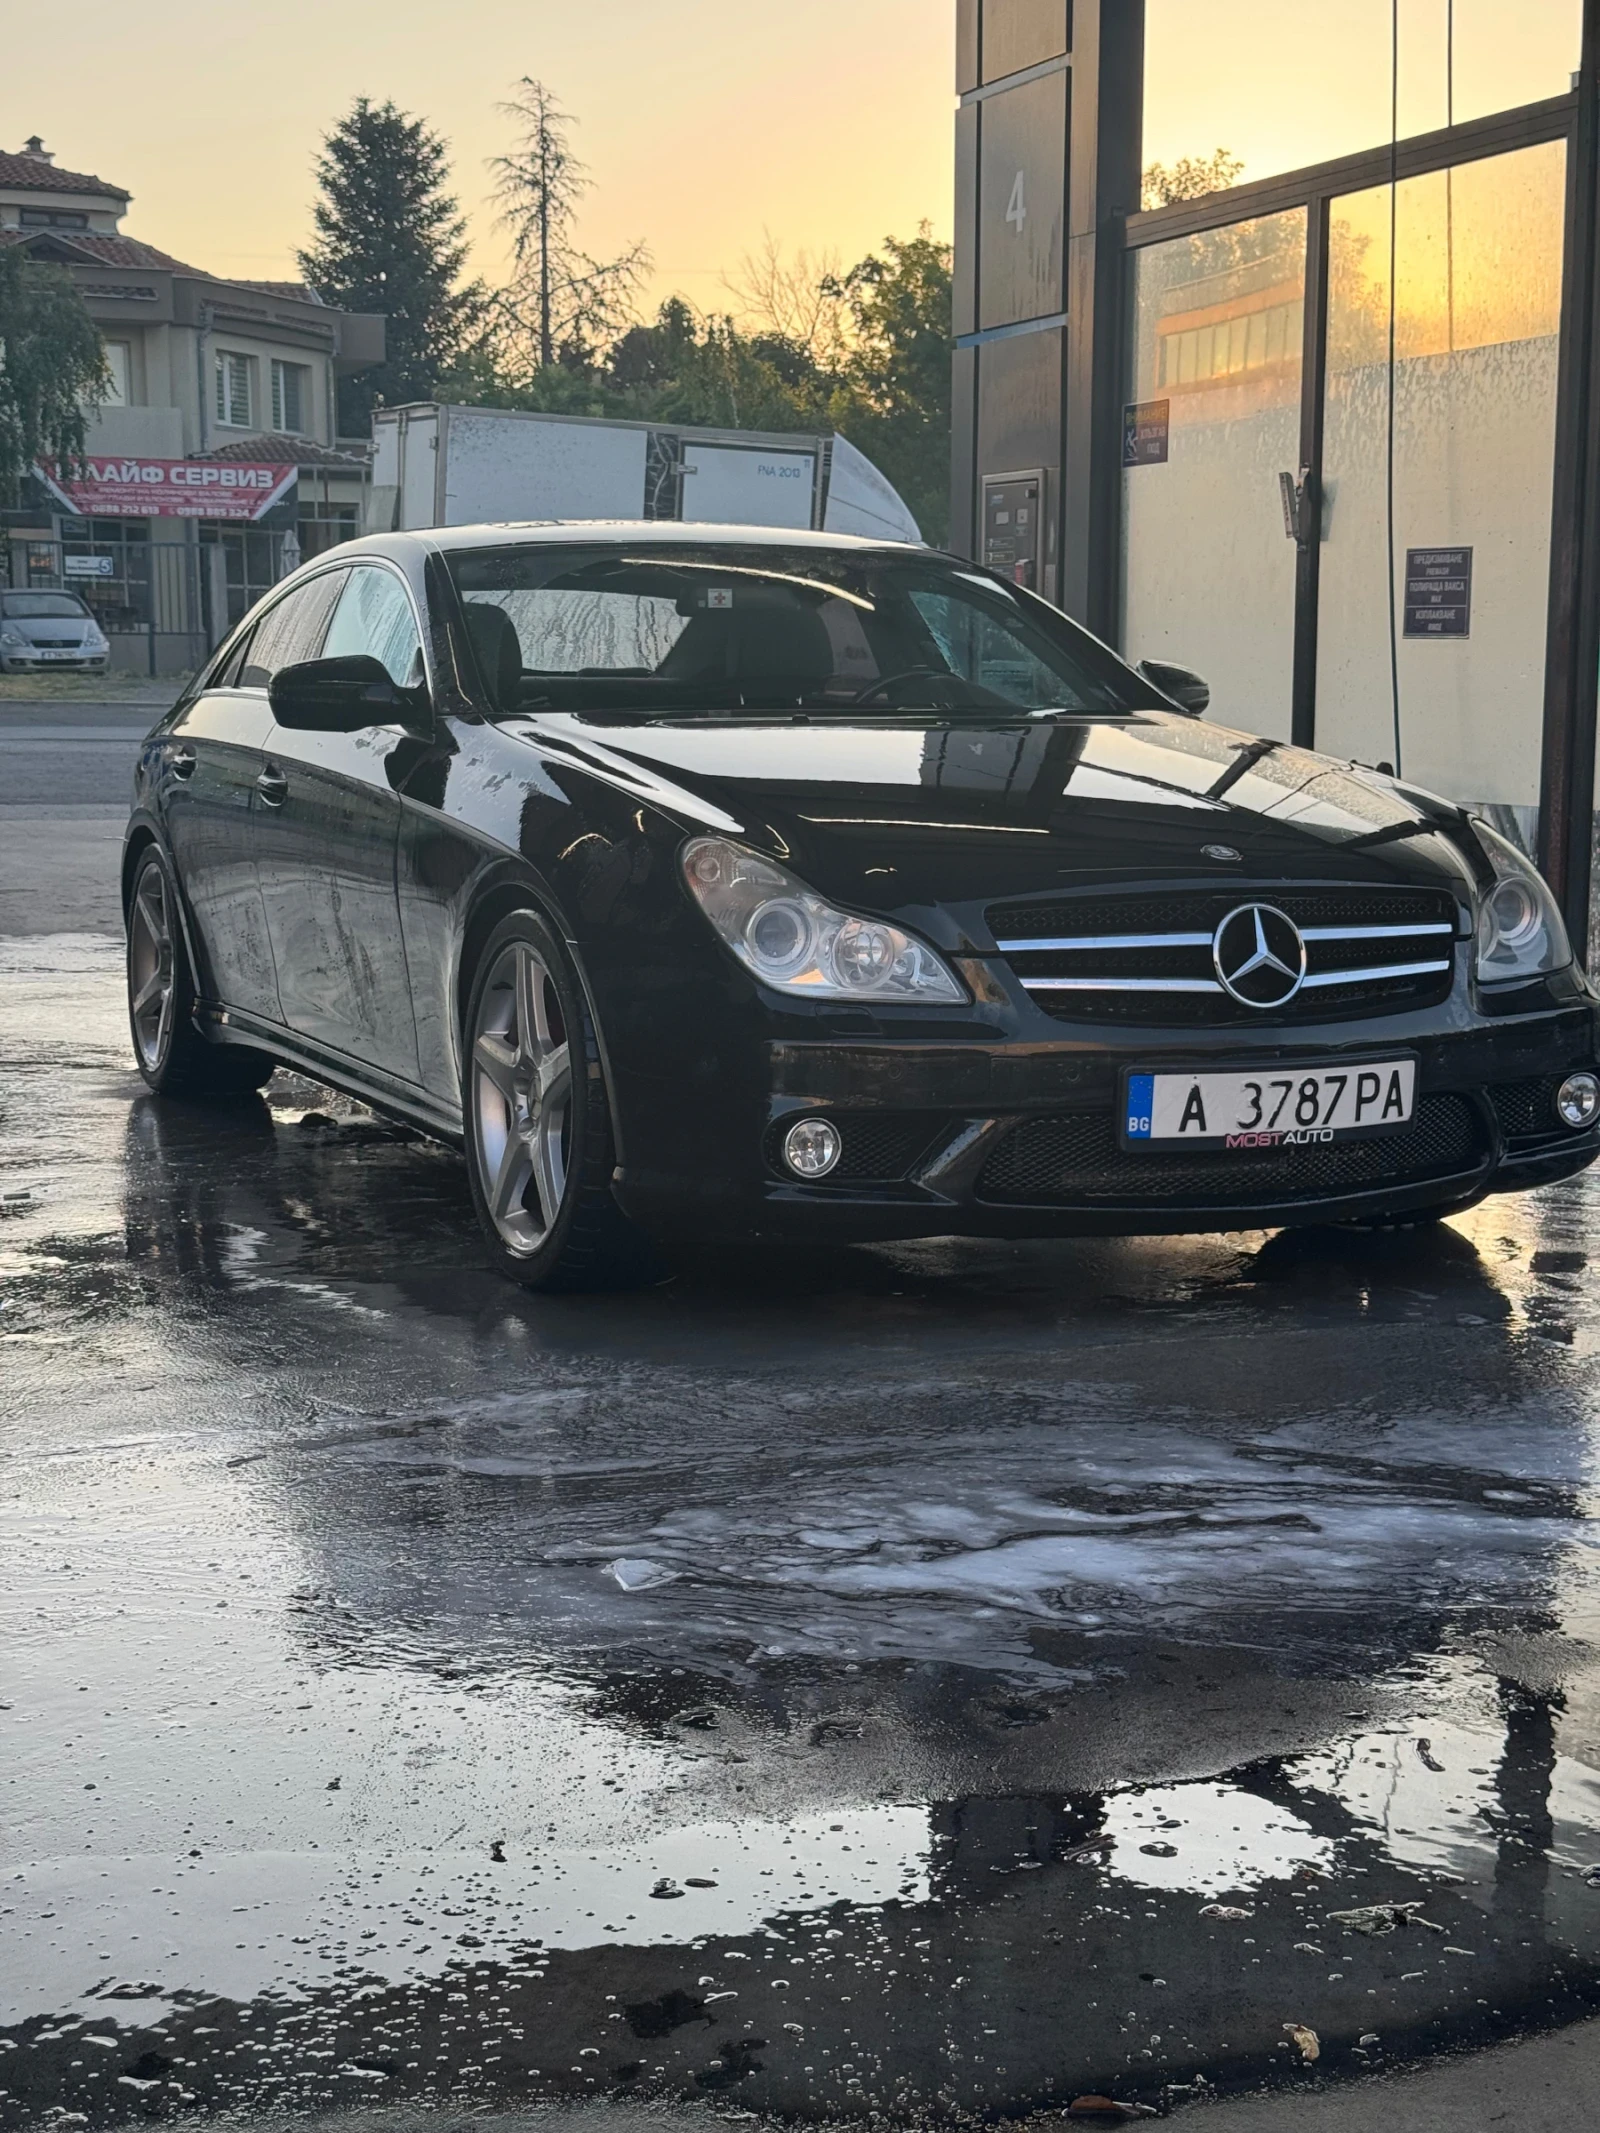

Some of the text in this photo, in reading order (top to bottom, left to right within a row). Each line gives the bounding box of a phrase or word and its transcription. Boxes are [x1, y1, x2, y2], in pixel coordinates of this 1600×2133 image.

[1005, 170, 1026, 233] 4
[169, 467, 274, 488] СЕРВИЗ
[121, 505, 140, 514] 212
[1178, 1083, 1207, 1132] A
[1128, 1117, 1149, 1132] BG
